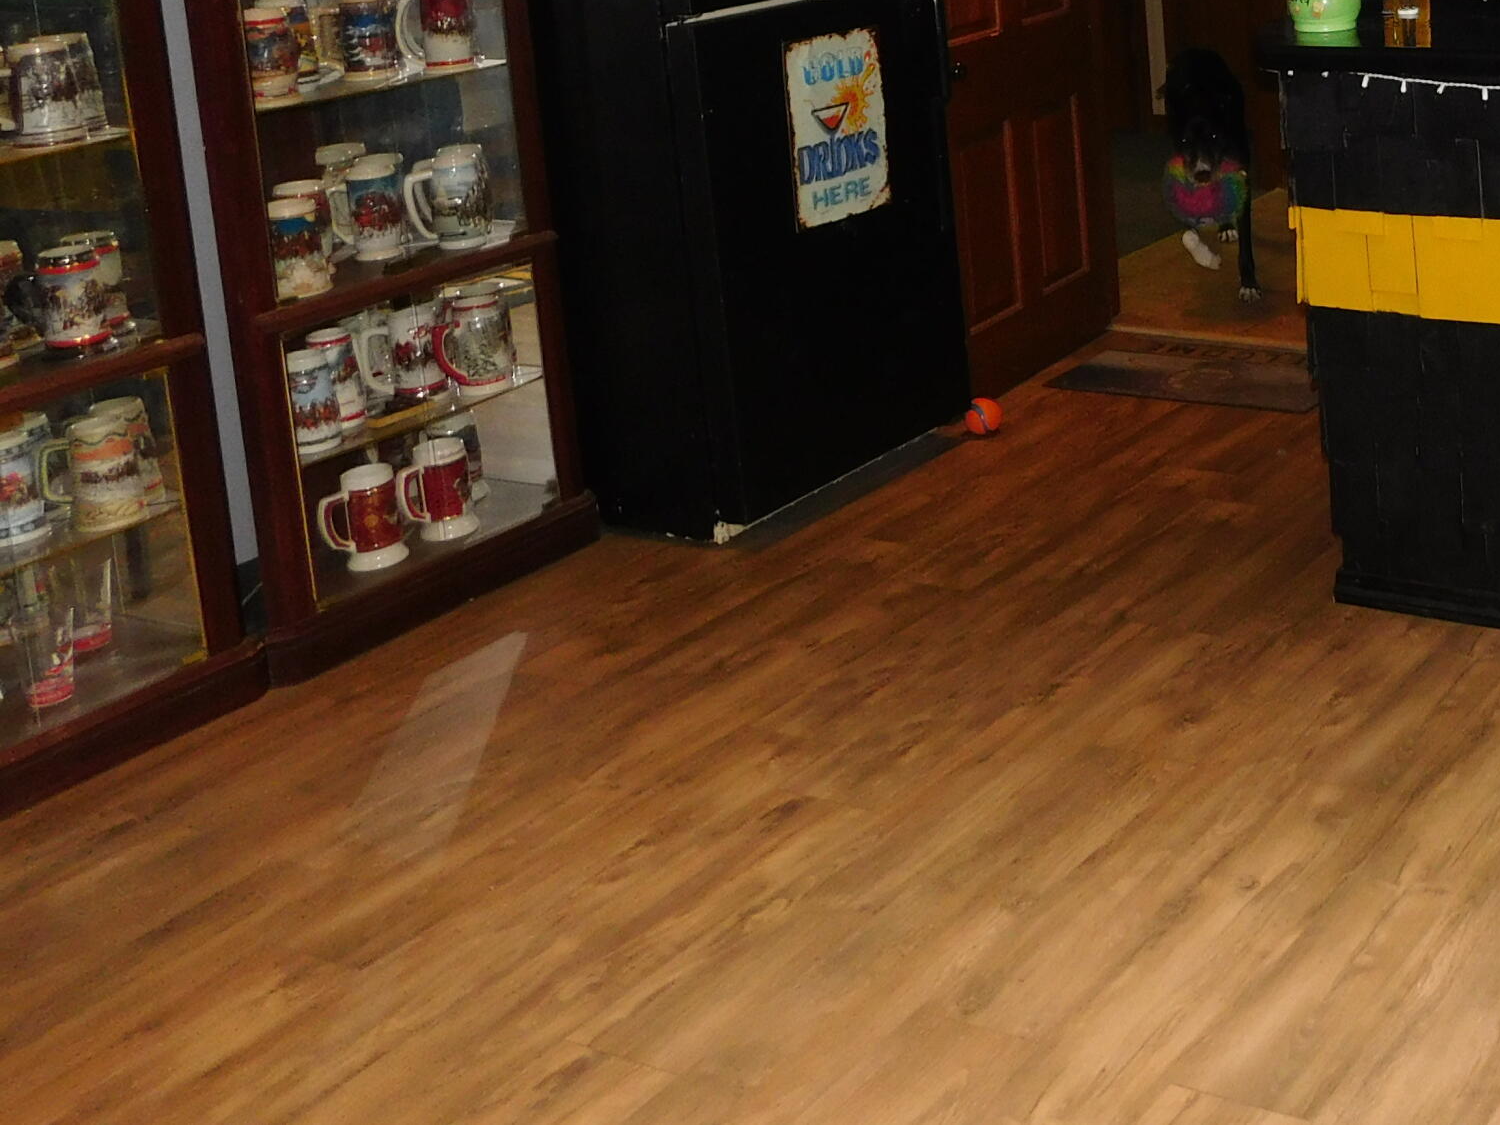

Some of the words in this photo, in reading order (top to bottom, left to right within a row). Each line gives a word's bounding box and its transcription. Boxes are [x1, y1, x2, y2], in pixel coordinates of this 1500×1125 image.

[802, 47, 864, 86] COLD
[798, 128, 881, 185] DRINKS
[812, 176, 873, 211] HERE
